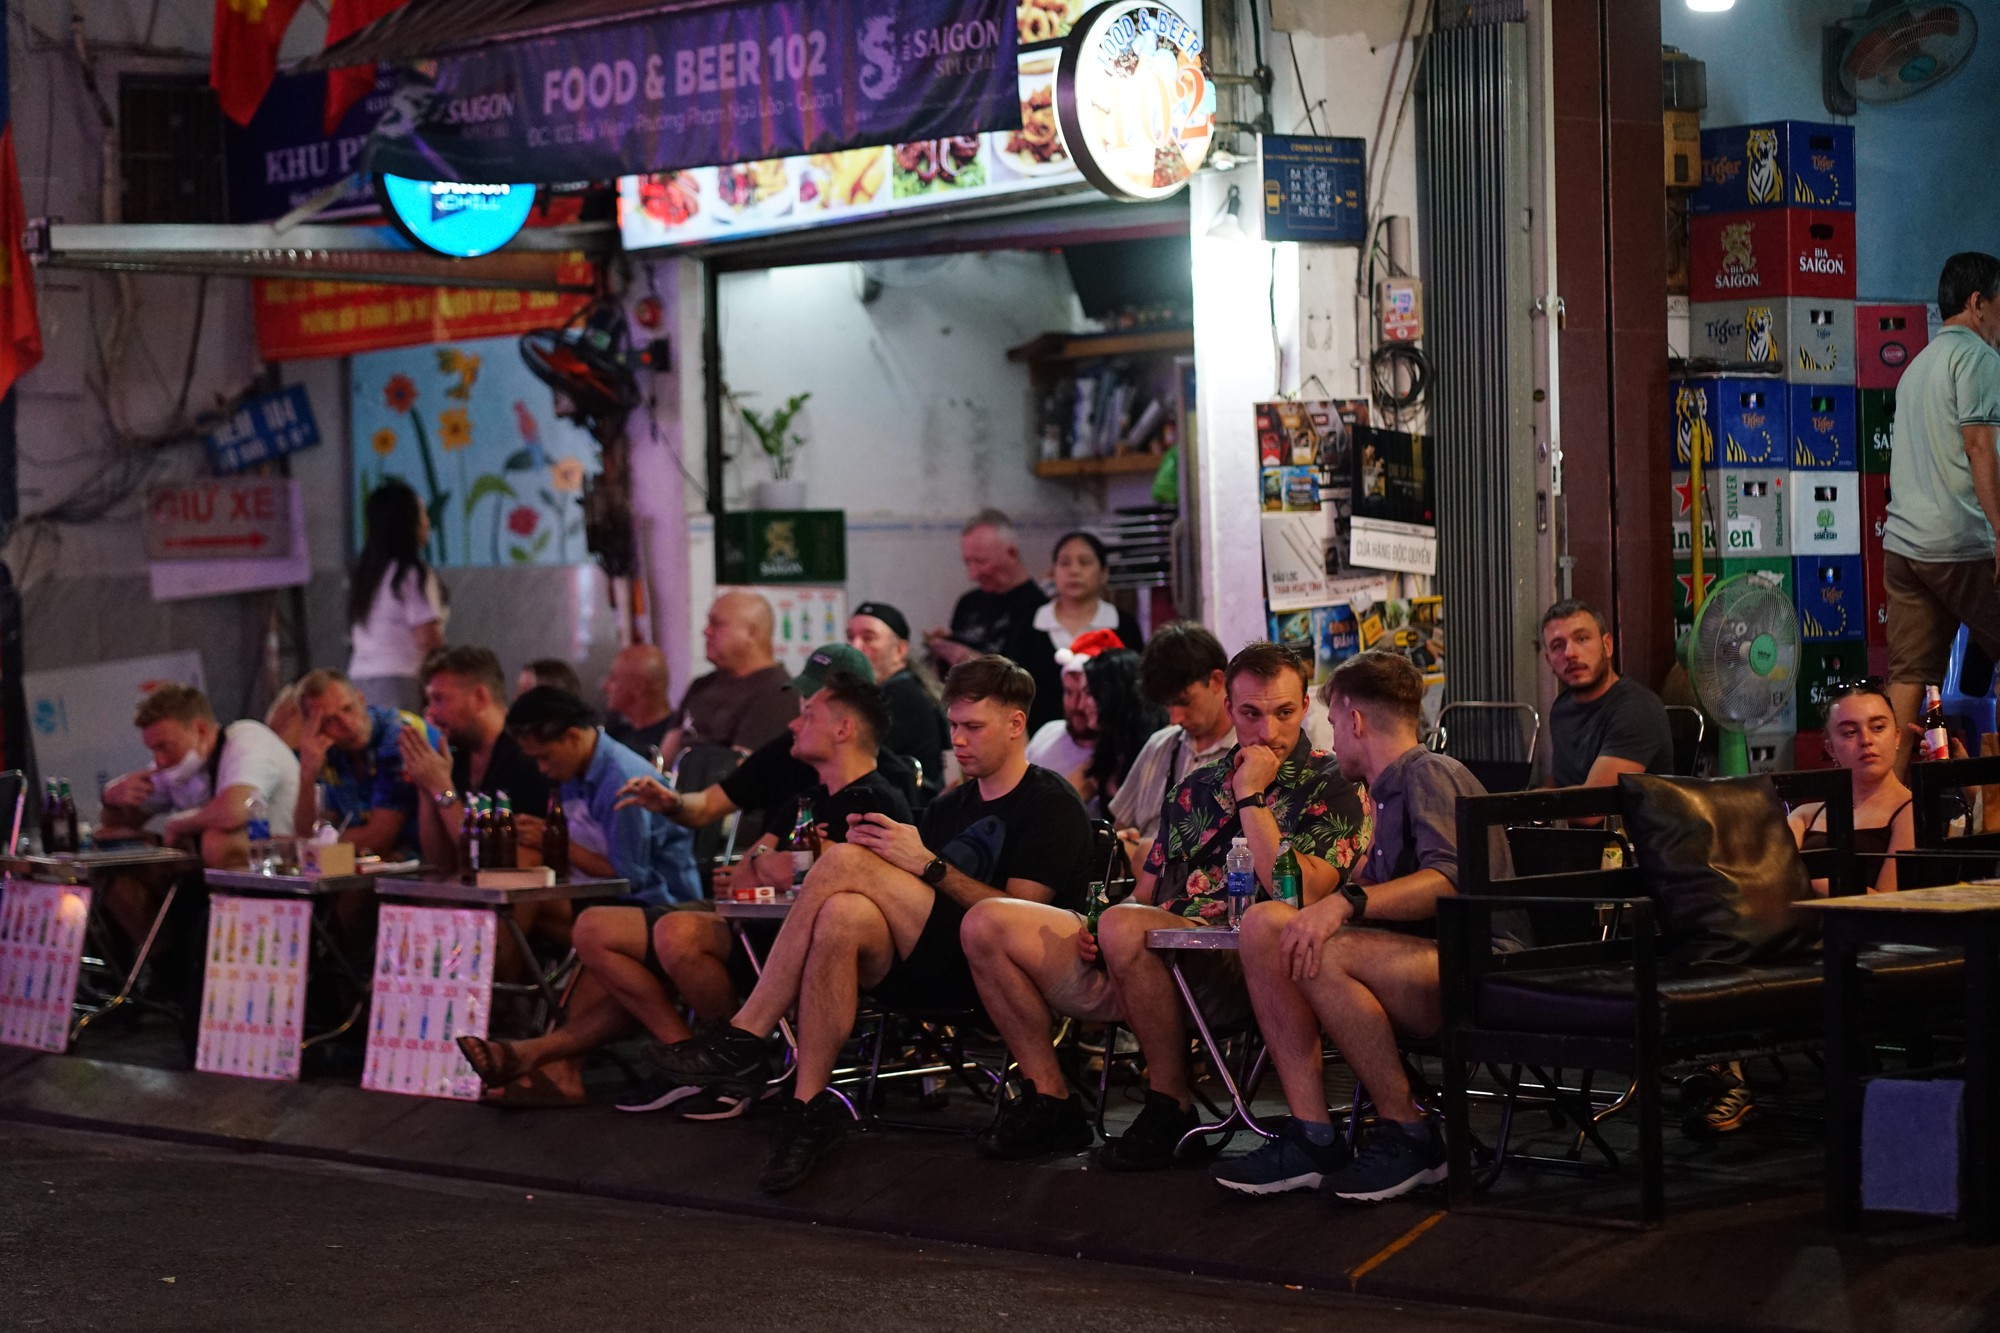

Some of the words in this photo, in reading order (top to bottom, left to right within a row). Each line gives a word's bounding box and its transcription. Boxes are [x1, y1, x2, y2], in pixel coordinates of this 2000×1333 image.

[914, 20, 999, 59] SAIGON
[1139, 10, 1151, 32] &
[1158, 11, 1200, 60] BEER
[543, 59, 638, 115] FOOD
[644, 54, 665, 100] &
[675, 39, 761, 96] BEER
[769, 30, 827, 82] 102
[448, 92, 515, 124] SAIGON
[266, 141, 330, 183] KHU
[338, 134, 368, 172] P
[1811, 154, 1836, 172] Tiger
[1701, 154, 1741, 184] Tiger
[1814, 248, 1828, 259] BIA
[1730, 265, 1744, 275] BIA
[1800, 255, 1844, 275] SAIGON
[1715, 272, 1760, 289] SAIGON
[1705, 318, 1743, 345] Tiger
[1816, 328, 1831, 340] Tiger
[1741, 412, 1766, 431] Tiger
[1812, 416, 1835, 433] Tiger
[230, 486, 273, 521] XE
[1727, 475, 1738, 518] SILVER
[1820, 587, 1843, 605] Tiger
[1827, 676, 1841, 687] BIA
